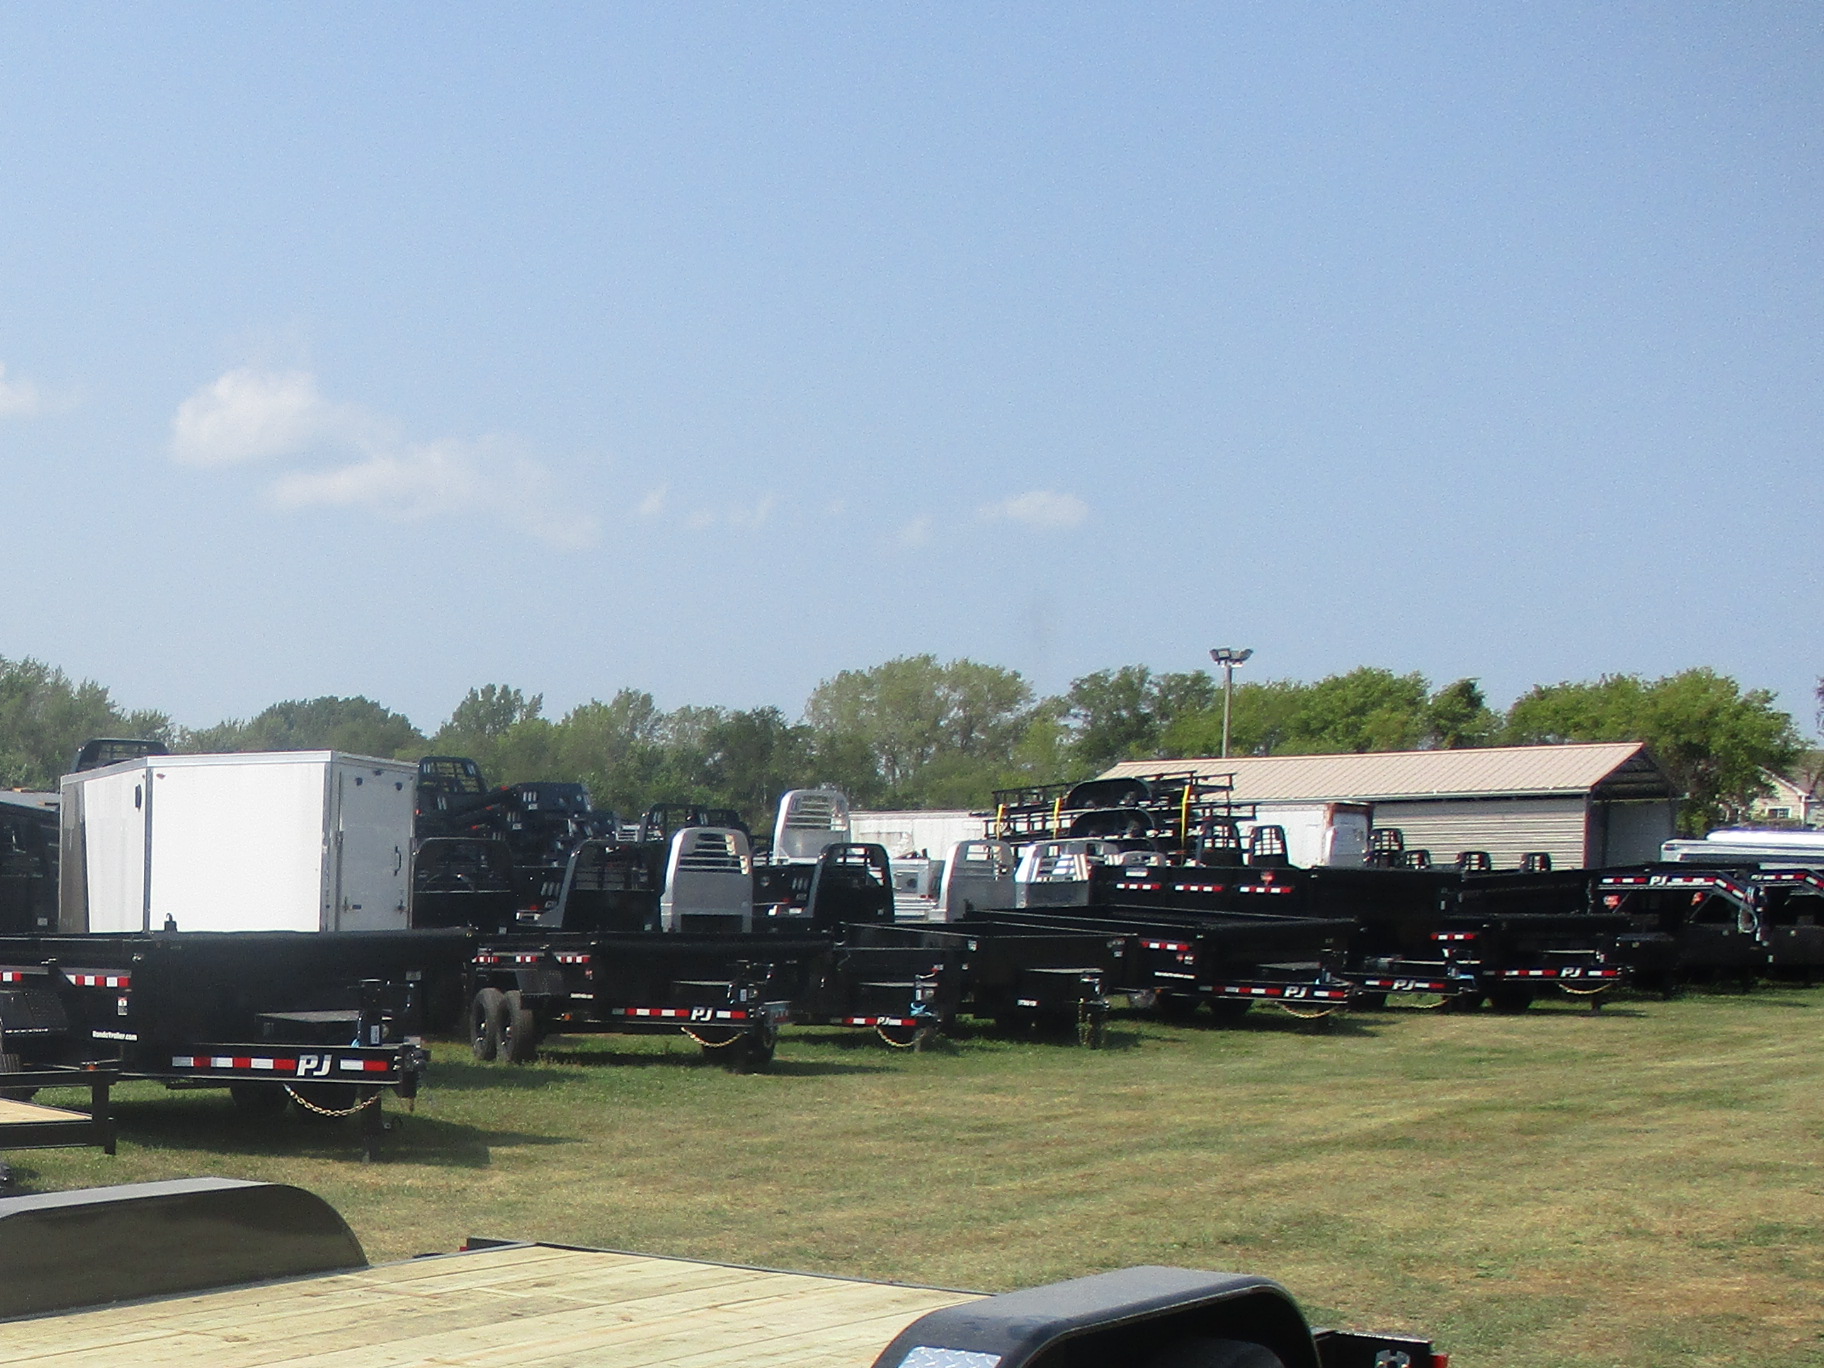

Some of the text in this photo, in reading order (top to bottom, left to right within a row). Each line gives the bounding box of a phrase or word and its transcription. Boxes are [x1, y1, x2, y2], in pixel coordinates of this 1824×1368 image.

[1649, 876, 1668, 886] PJ
[1559, 966, 1582, 978] PJ
[1392, 980, 1416, 991] PJ
[1283, 986, 1308, 998] PJ
[690, 1006, 714, 1022] PJ
[876, 1016, 890, 1026] PJ
[296, 1054, 332, 1077] PJ
